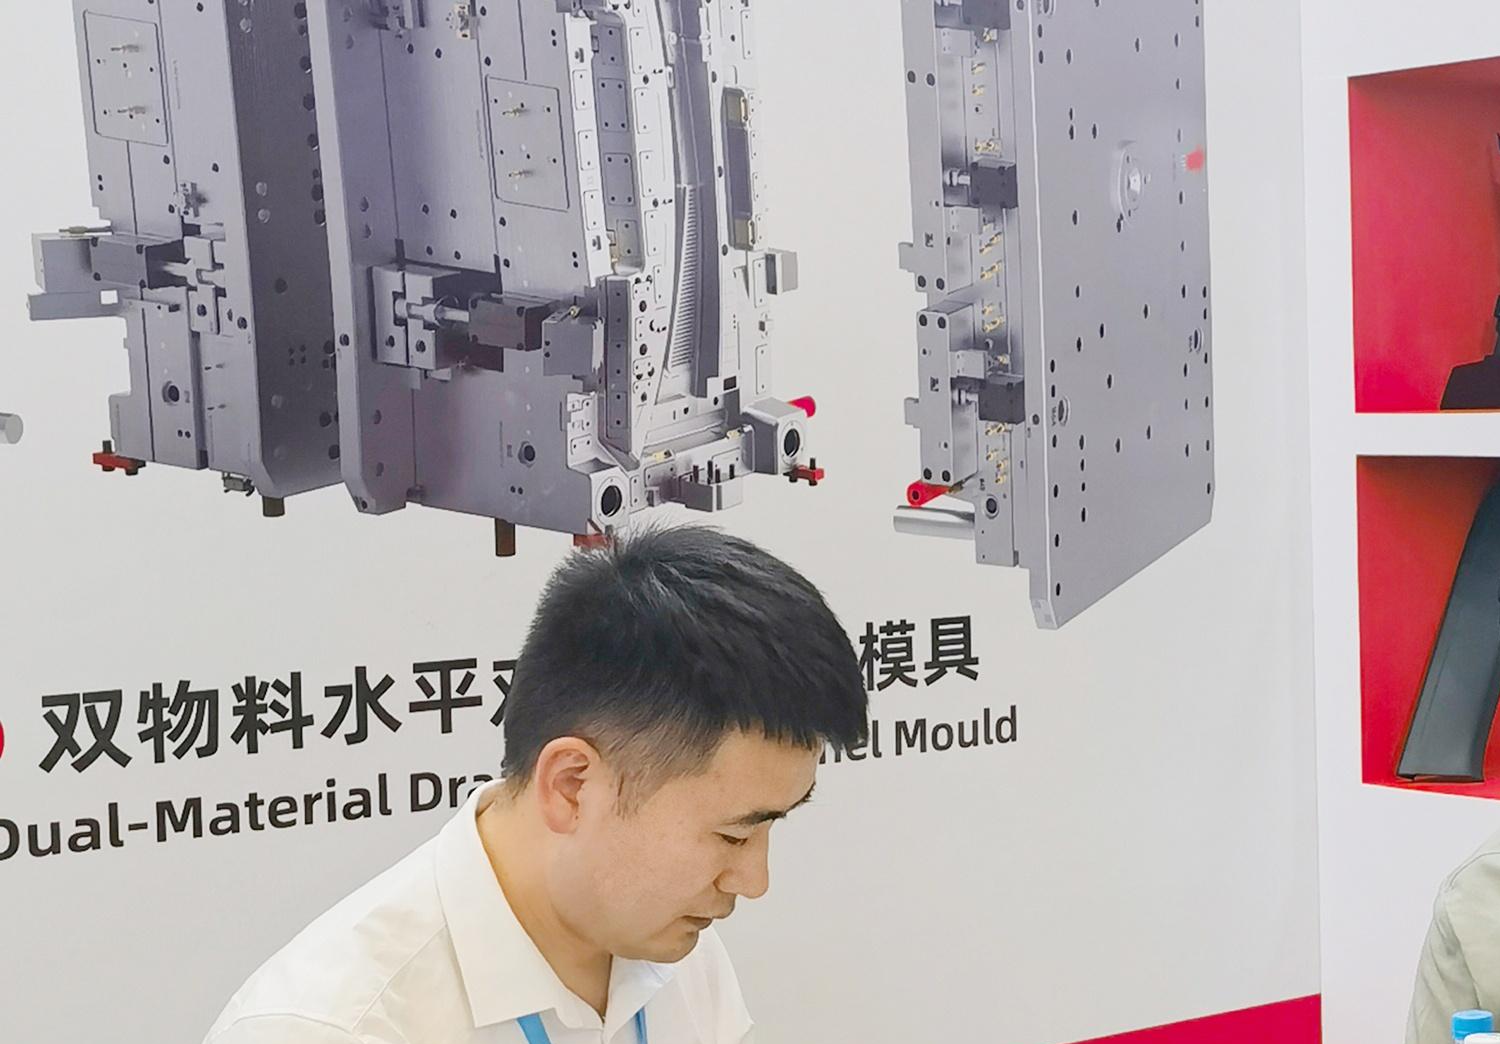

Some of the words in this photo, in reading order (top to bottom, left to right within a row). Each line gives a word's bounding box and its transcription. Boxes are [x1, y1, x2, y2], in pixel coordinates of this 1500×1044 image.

[858, 615, 980, 692] 模具
[0, 773, 392, 861] Dual-Material
[895, 705, 1018, 756] Mould
